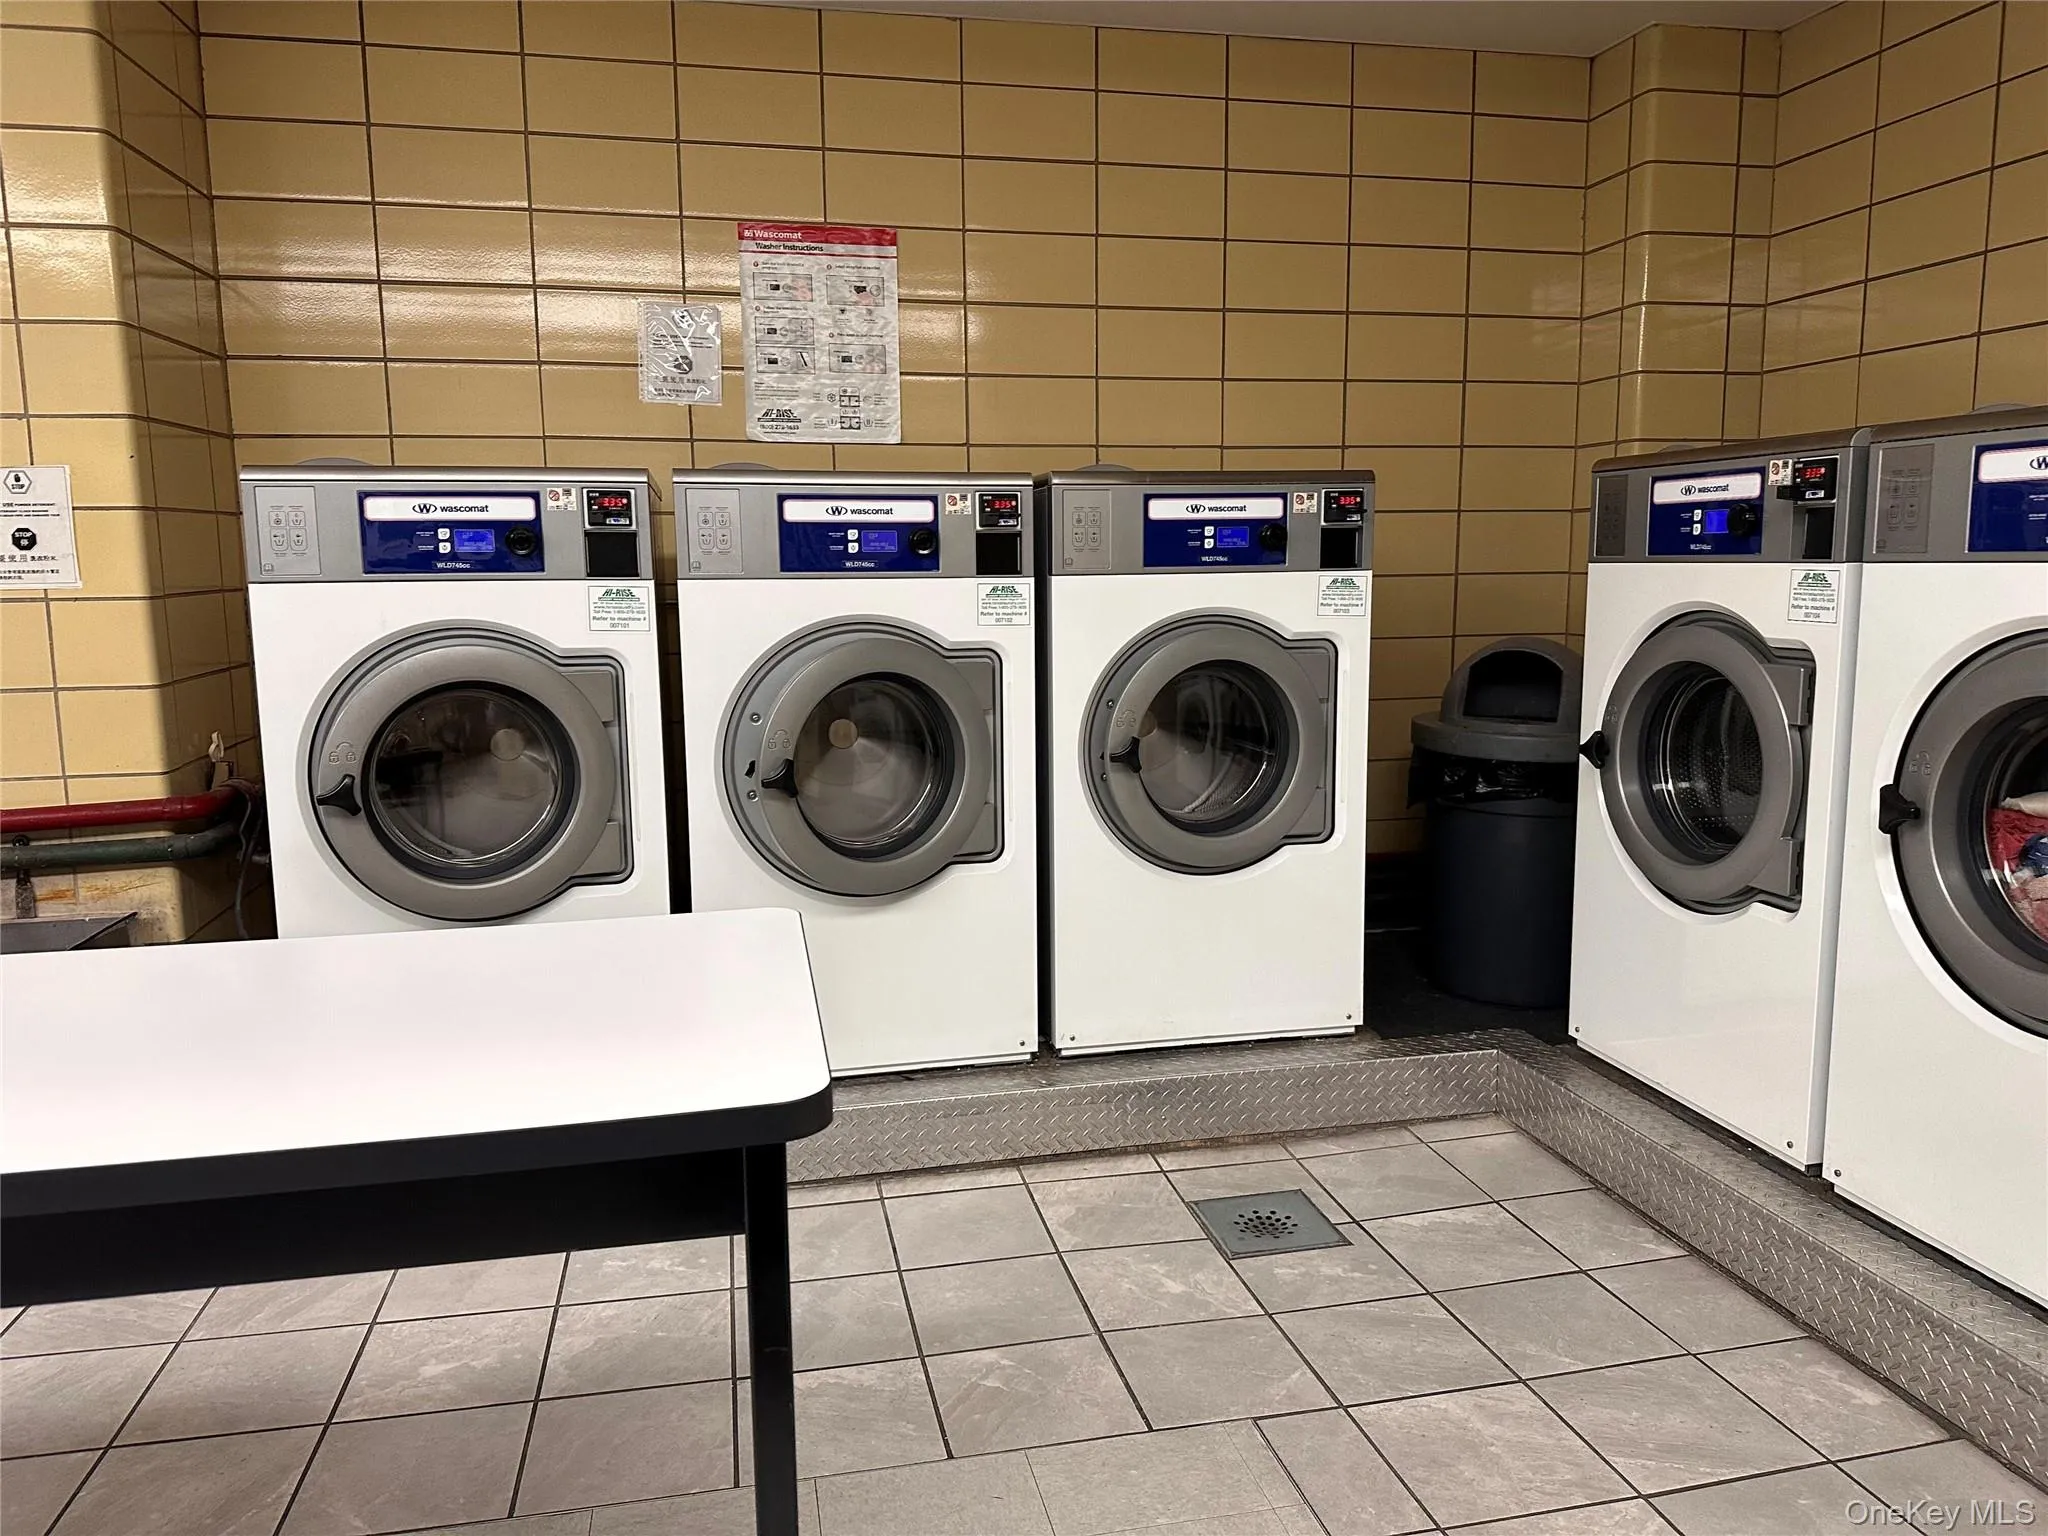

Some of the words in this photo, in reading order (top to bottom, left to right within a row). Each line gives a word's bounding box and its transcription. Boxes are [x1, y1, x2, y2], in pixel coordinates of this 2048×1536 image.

[754, 230, 802, 239] Wascomat
[756, 242, 782, 250] Washer
[783, 244, 824, 252] Instructions
[1697, 484, 1729, 493] wascomat
[602, 589, 635, 597] HI-RISE
